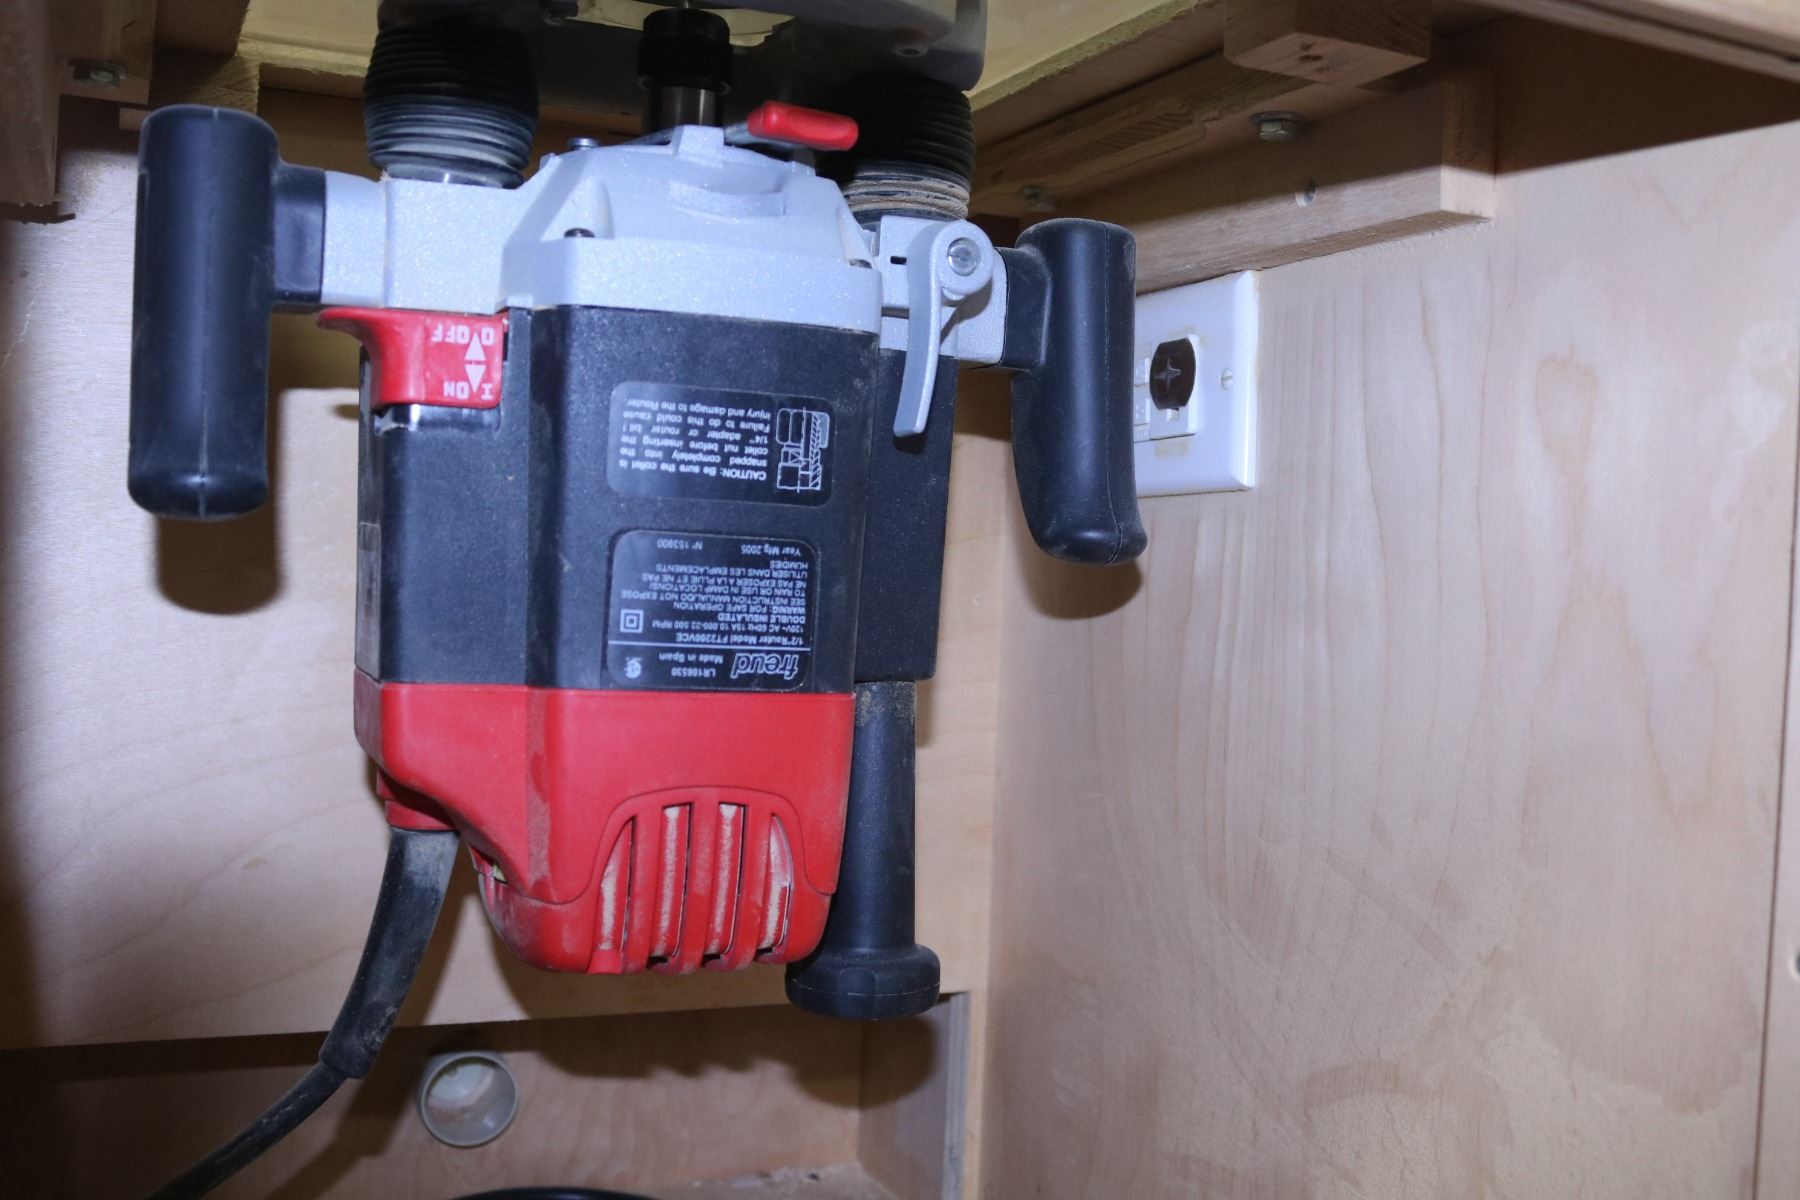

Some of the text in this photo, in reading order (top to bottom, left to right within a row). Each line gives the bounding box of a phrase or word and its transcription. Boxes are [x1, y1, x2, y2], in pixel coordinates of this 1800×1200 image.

[431, 323, 470, 344] OFF
[443, 380, 470, 400] ON
[624, 398, 771, 420] injury and damage to the Router.
[623, 411, 770, 432] Failure to do this could cause
[629, 423, 641, 434] bit
[651, 426, 680, 436] router
[688, 429, 698, 437] or
[706, 429, 742, 441] adapter
[621, 435, 768, 455] collet nut before inserting the
[620, 448, 767, 467] snapped completely into the
[619, 460, 767, 481] CAUTION: Be sure the collet is
[782, 547, 801, 556] Year
[655, 563, 807, 579] UTILISER DANS LES EMPLACEMENTS
[642, 573, 660, 582] PAS
[662, 574, 674, 582] NE
[676, 574, 688, 583] ET
[690, 575, 714, 584] PLUIE
[737, 578, 776, 586] EXPOSER
[778, 579, 794, 587] PAS
[795, 580, 806, 588] NE
[704, 584, 728, 593] DAMP
[741, 586, 758, 595] USE
[760, 587, 772, 595] OR
[774, 588, 792, 596] RAIN
[794, 589, 805, 597] TO
[621, 590, 657, 600] EXPOSE
[659, 592, 678, 601] NOT
[733, 595, 788, 605] INSTRUCTION
[790, 597, 806, 605] SEE
[673, 601, 723, 611] OPERATION
[726, 603, 747, 612] SAFE
[750, 605, 767, 613] FOR
[718, 613, 805, 623] DOUBLE INSULATED
[652, 620, 672, 629] RPM
[731, 623, 746, 631] 15A
[769, 624, 780, 632] AC
[731, 634, 757, 644] Model
[659, 652, 723, 664] Made in Spain
[731, 653, 799, 680] freud
